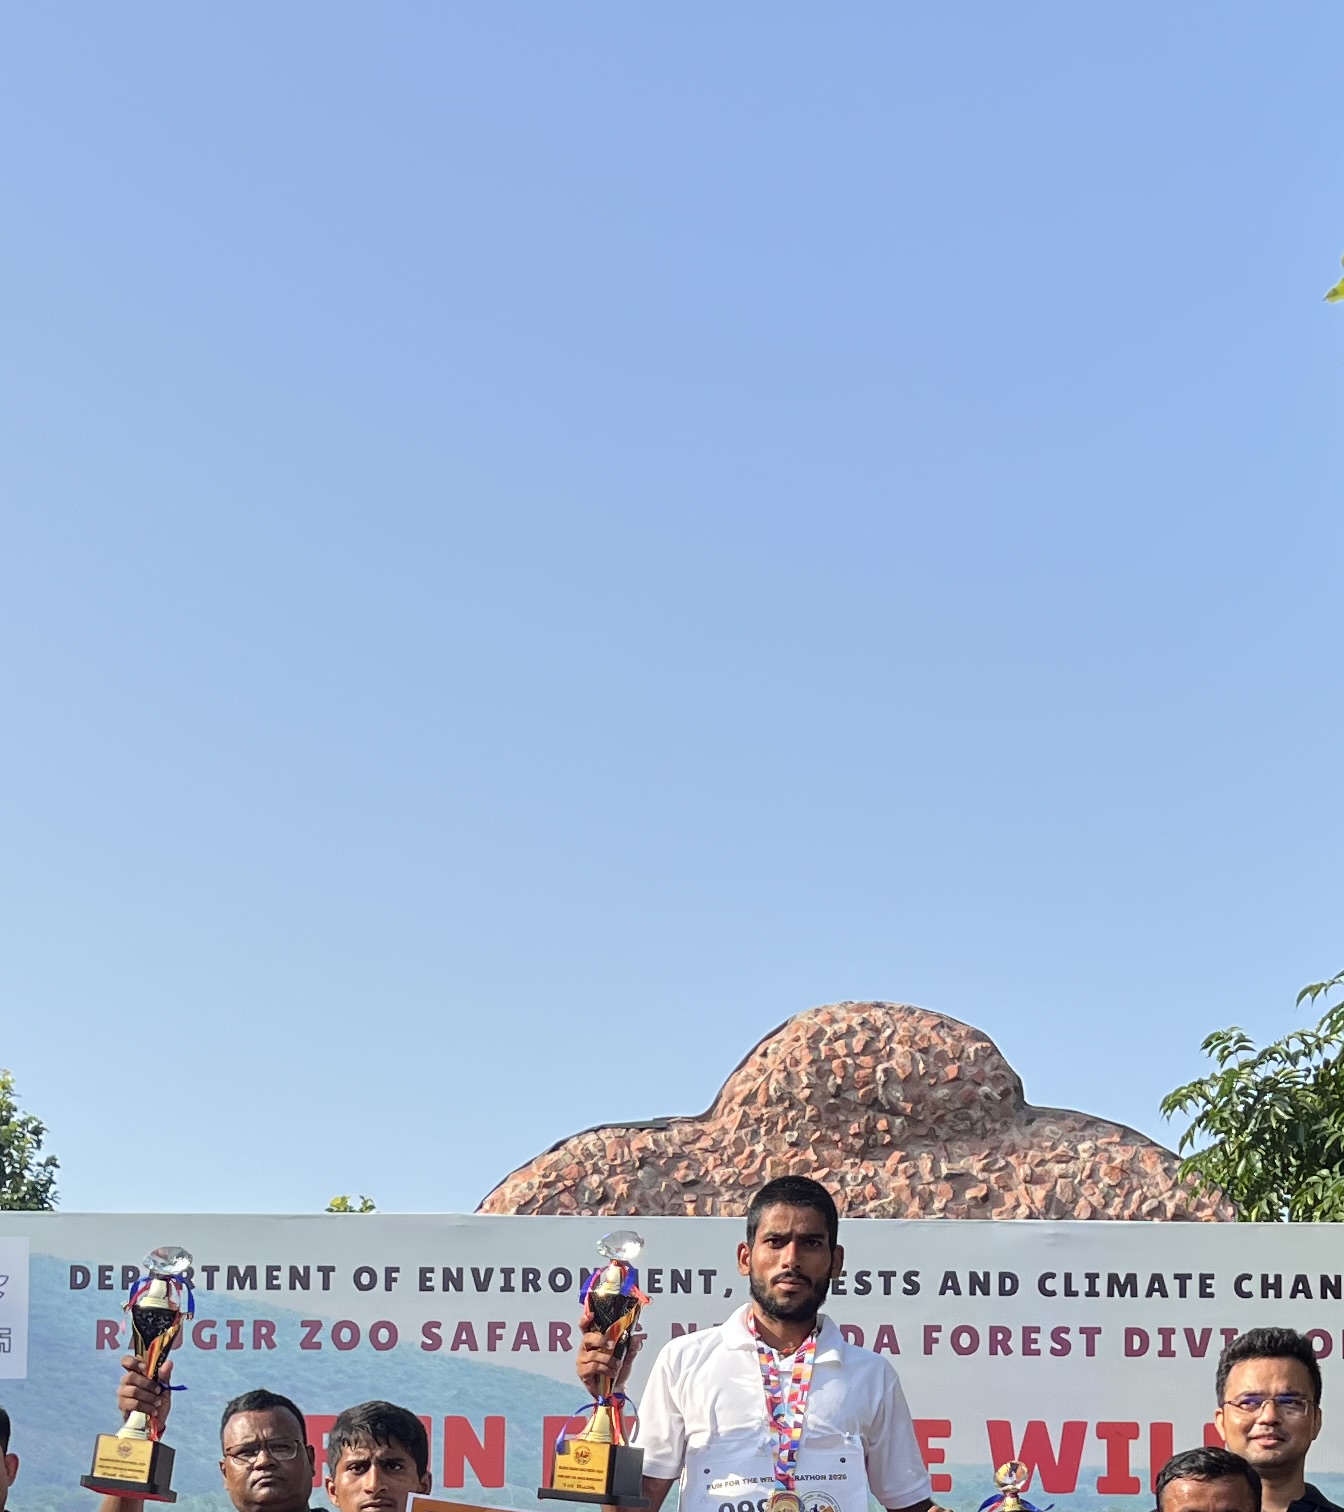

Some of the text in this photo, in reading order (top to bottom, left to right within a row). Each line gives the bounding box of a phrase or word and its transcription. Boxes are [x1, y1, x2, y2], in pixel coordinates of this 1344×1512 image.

[353, 1265, 400, 1292] OF
[938, 1270, 1020, 1297] AND
[1037, 1271, 1216, 1299] CLIMATE
[299, 1319, 400, 1352] ZOO
[420, 1320, 574, 1352] SAFAR
[922, 1324, 1103, 1357] FOREST
